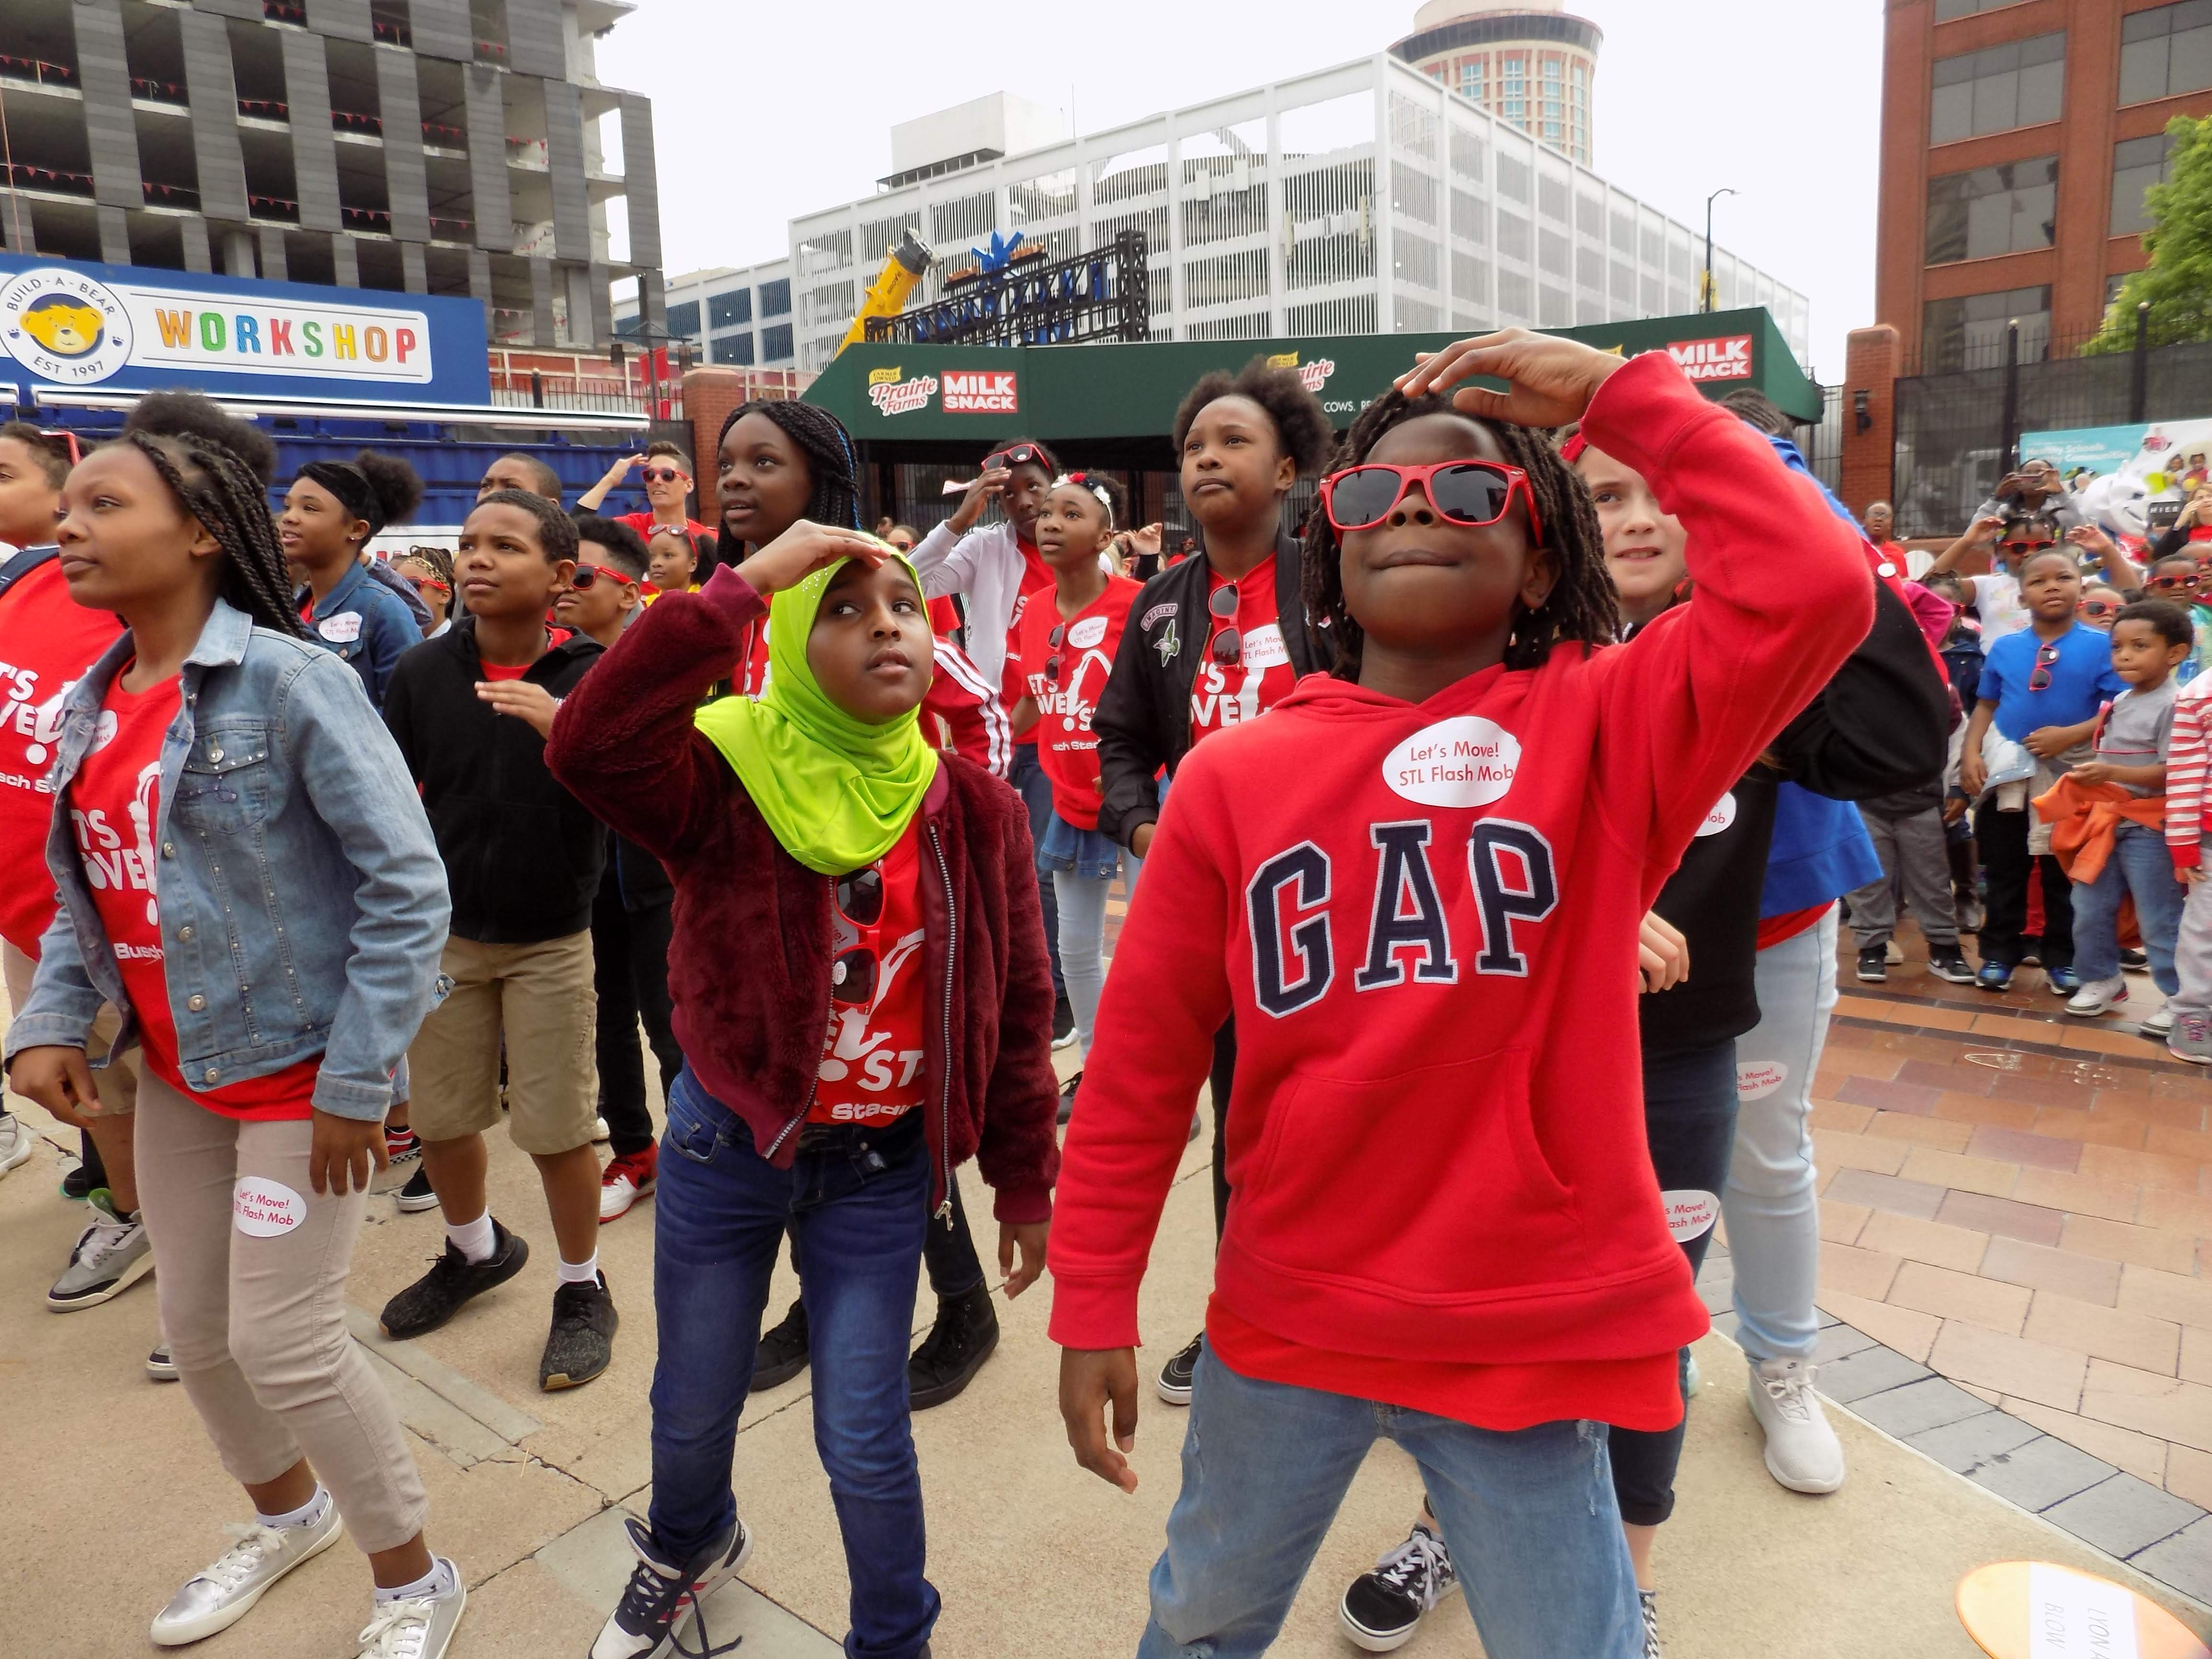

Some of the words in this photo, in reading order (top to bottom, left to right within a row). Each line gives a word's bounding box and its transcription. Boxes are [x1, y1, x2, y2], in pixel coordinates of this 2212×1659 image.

[156, 309, 416, 364] WORKSHOP
[1668, 340, 1748, 365] MILK
[34, 356, 62, 375] EST
[72, 360, 104, 377] 1997
[1682, 362, 1748, 379] NACK
[871, 377, 935, 402] Prairie
[944, 375, 1014, 395] MILK
[883, 397, 925, 413] Farms
[945, 396, 1015, 409] SNACK
[1323, 401, 1356, 412] COWS.
[1245, 640, 1262, 648] Let's
[1255, 647, 1275, 658] Flash
[1411, 744, 1447, 761] Let's
[1454, 741, 1499, 758] Move!
[1399, 769, 1425, 786] STL
[1431, 765, 1473, 783] Flash
[1477, 763, 1514, 781] Mob
[1245, 817, 1559, 1019] GAP
[1745, 1067, 1773, 1079] Move!
[1761, 1075, 1781, 1086] Mob
[256, 1193, 290, 1209] Move!
[1675, 1200, 1705, 1214] Move!
[242, 1205, 264, 1221] Flash
[267, 1212, 294, 1225] Mob
[1691, 1211, 1711, 1225] Mob
